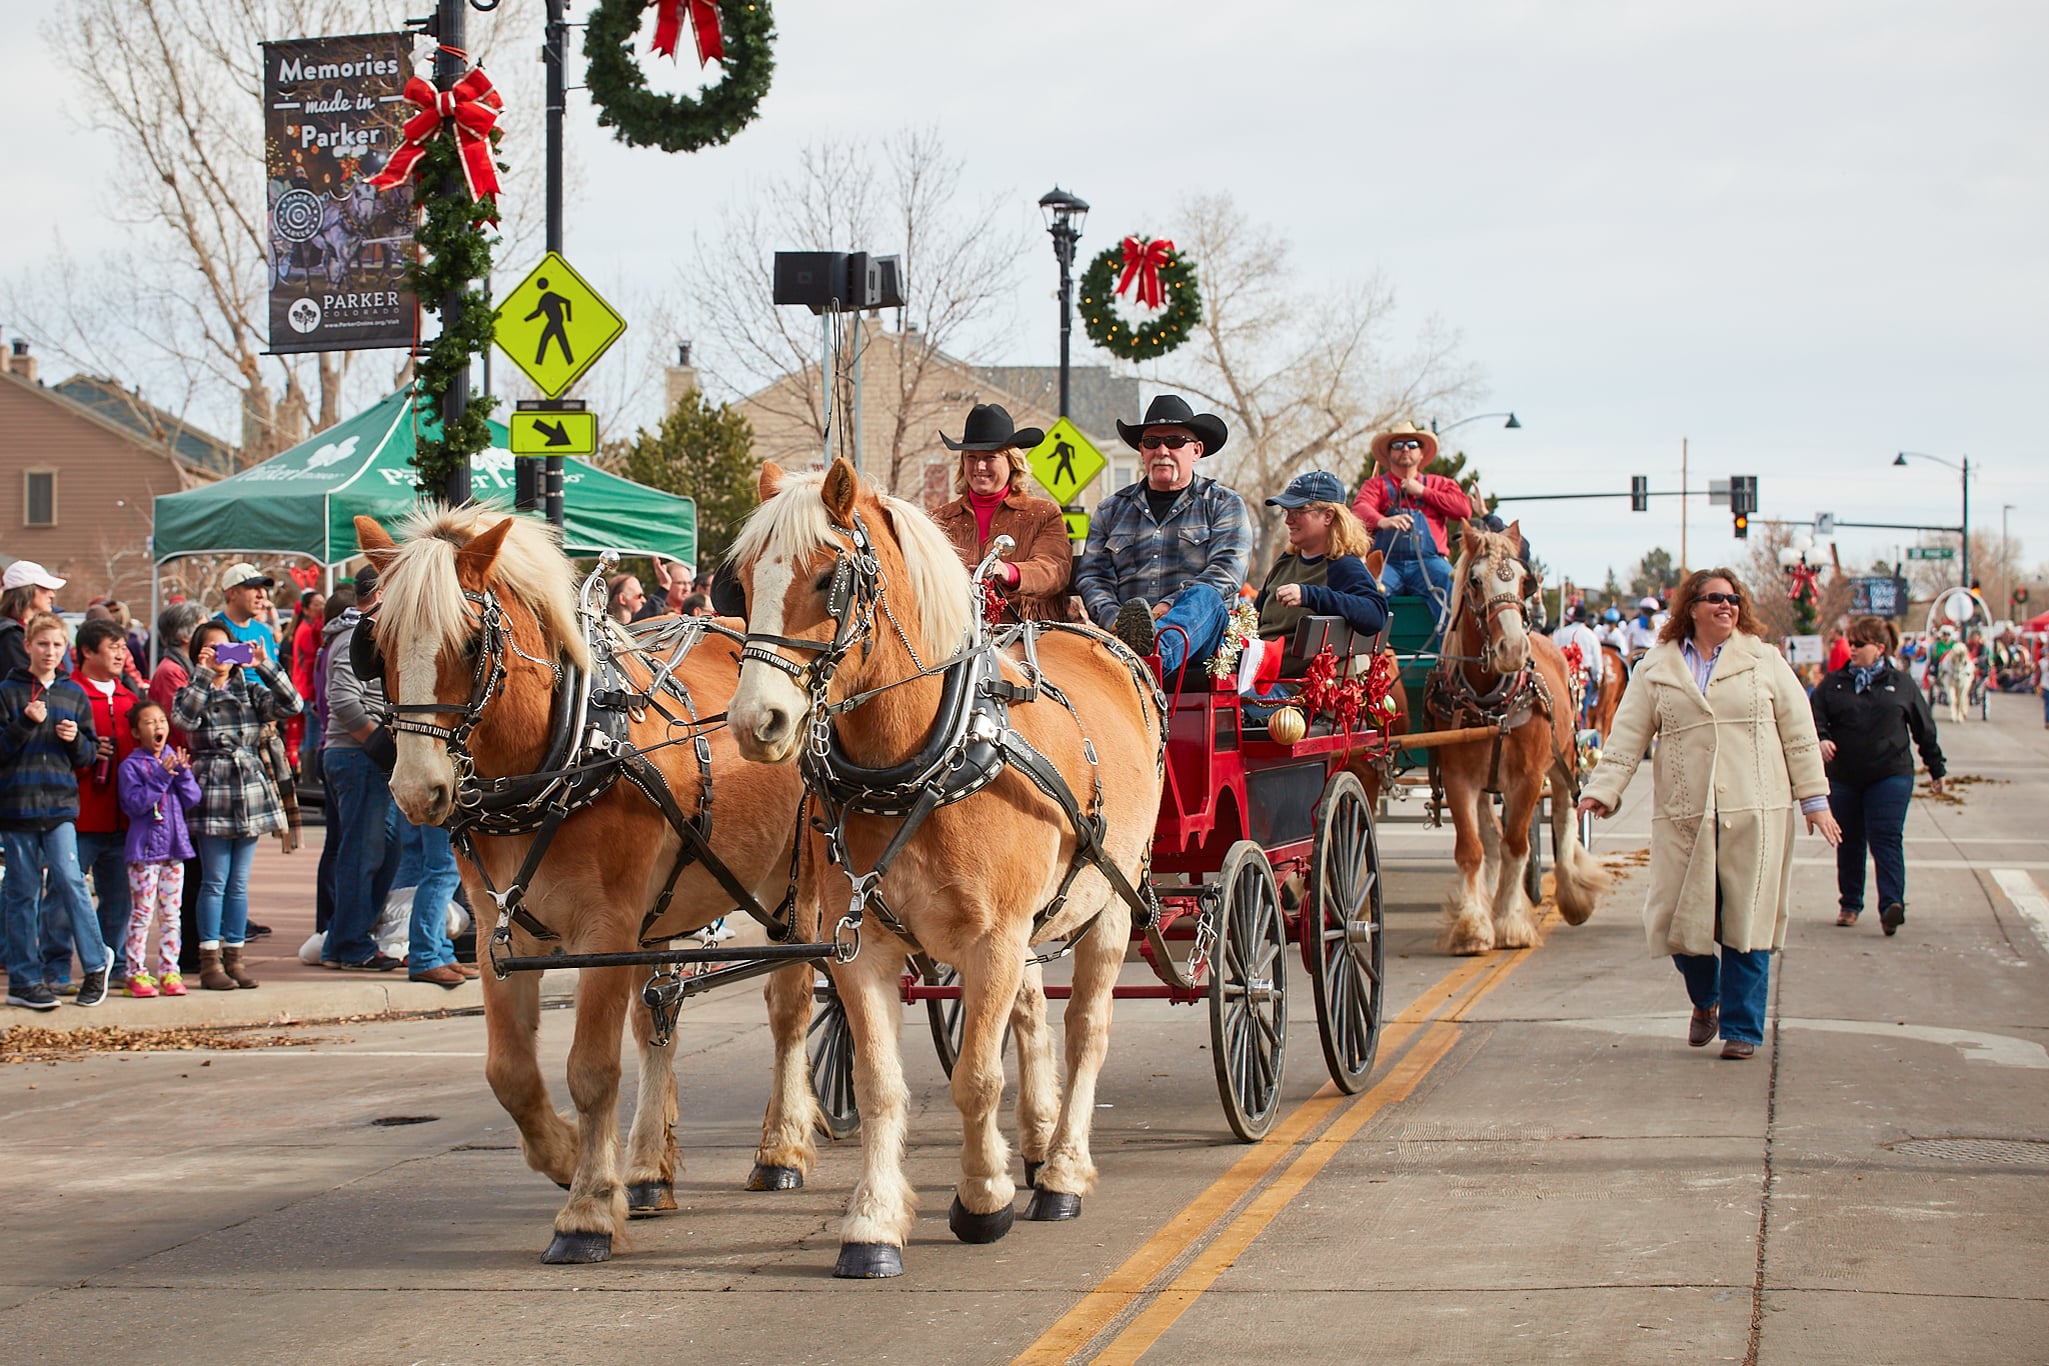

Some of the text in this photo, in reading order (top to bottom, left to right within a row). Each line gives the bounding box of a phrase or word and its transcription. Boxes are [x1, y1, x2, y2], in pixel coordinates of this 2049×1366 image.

[278, 53, 399, 82] Memories
[305, 89, 375, 114] made in
[301, 122, 380, 149] Parker
[323, 291, 399, 309] PARKER
[323, 307, 400, 318] COLORADO
